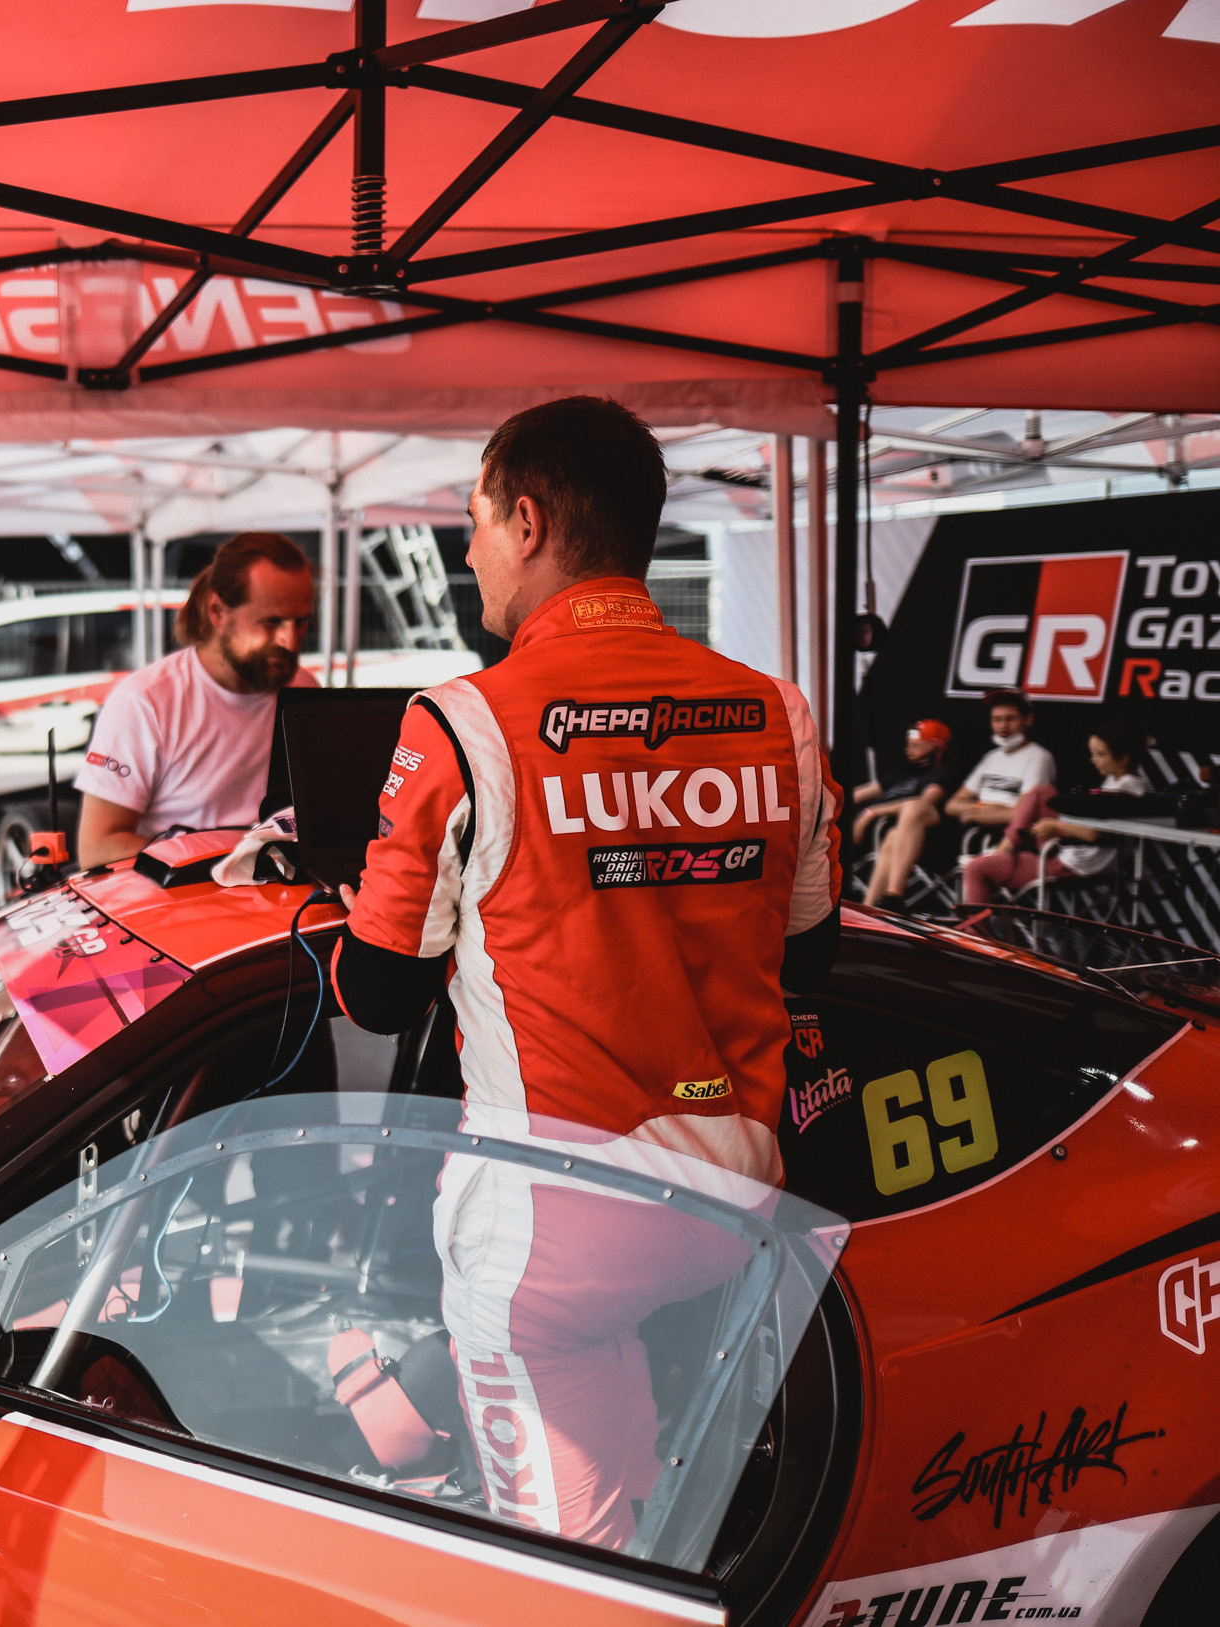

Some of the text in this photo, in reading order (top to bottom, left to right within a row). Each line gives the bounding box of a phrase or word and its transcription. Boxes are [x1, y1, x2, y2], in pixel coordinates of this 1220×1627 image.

[958, 613, 1106, 691] GR
[545, 701, 762, 748] CHEPA RACING
[542, 765, 791, 835] LUKOIL
[592, 851, 644, 864] RUSSIAN
[606, 861, 643, 873] DRIFT
[645, 848, 727, 882] RDS
[725, 844, 761, 870] GP
[596, 872, 642, 884] SERIES
[862, 1049, 999, 1196] 69
